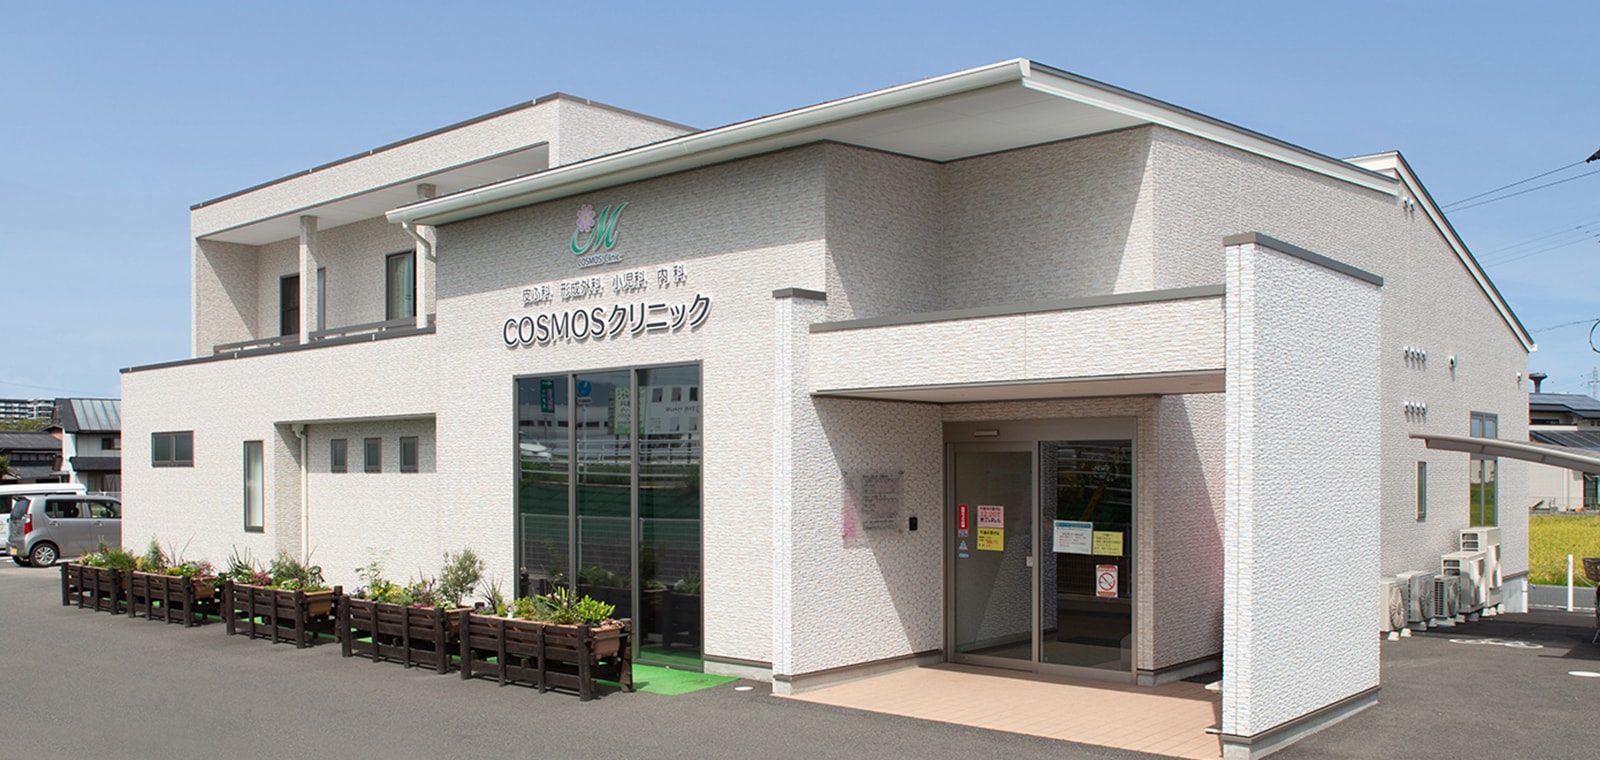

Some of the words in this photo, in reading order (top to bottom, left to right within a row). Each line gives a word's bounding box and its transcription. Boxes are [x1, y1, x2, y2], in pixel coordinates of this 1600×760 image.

[578, 255, 602, 267] COSMOS
[522, 286, 551, 303] 皮ふ科
[561, 277, 602, 299] 形成外科
[612, 270, 646, 291] 小児科
[502, 293, 710, 347] COSMOSクリニック
